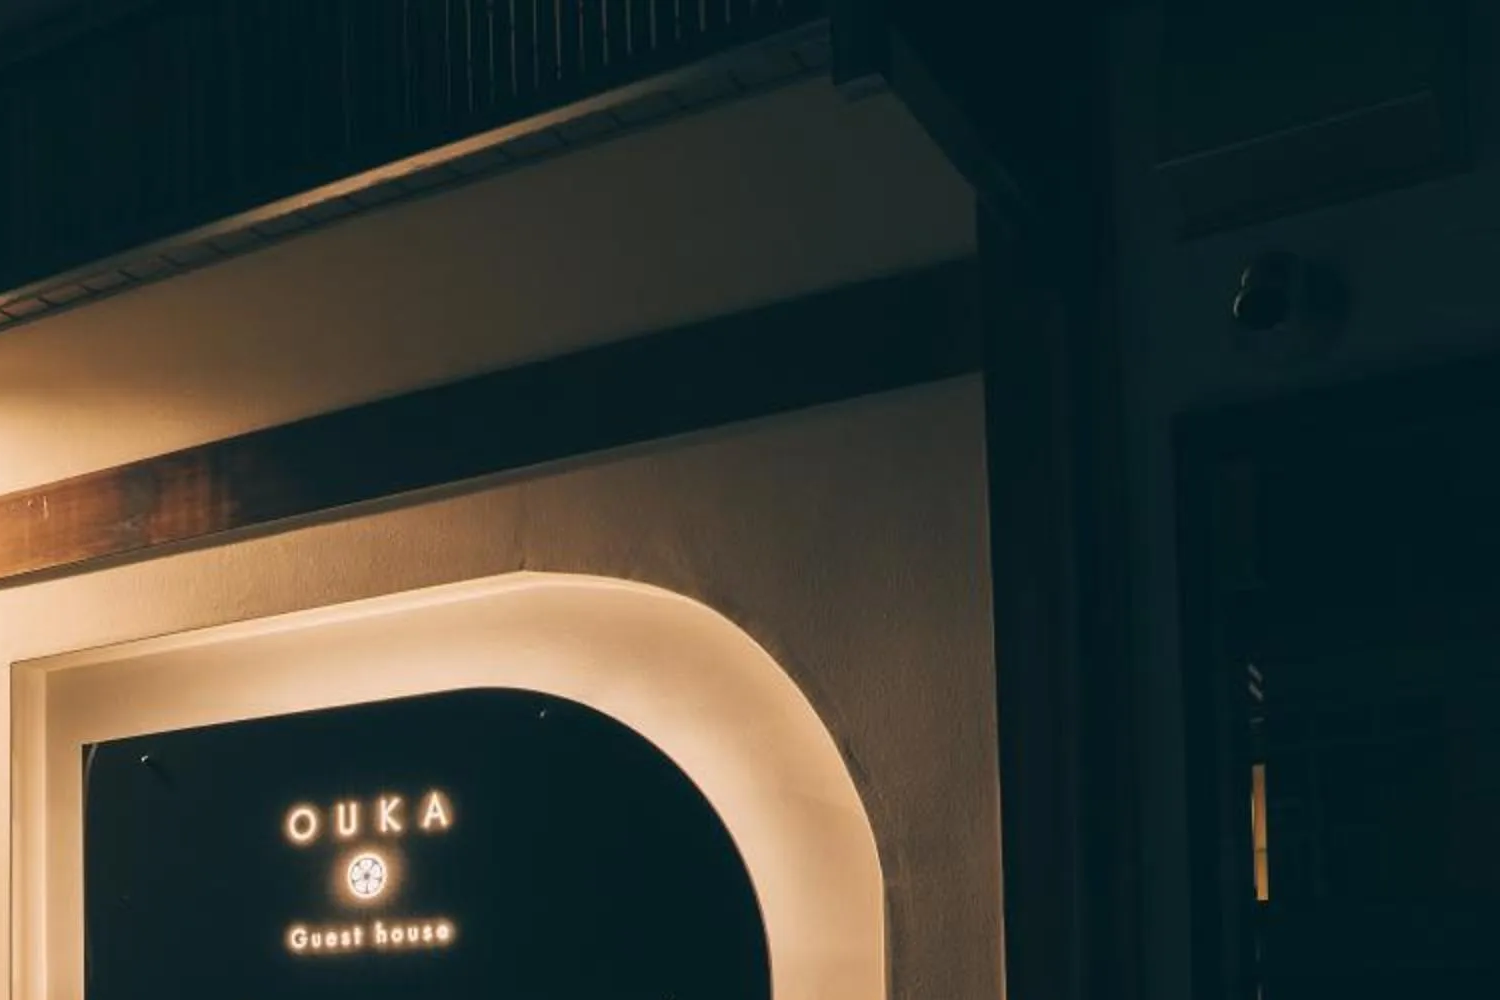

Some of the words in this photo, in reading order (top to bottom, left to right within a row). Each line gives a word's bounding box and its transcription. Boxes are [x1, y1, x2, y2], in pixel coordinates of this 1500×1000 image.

[288, 788, 451, 842] OUKA
[290, 926, 363, 949] Guest
[373, 919, 451, 943] house
